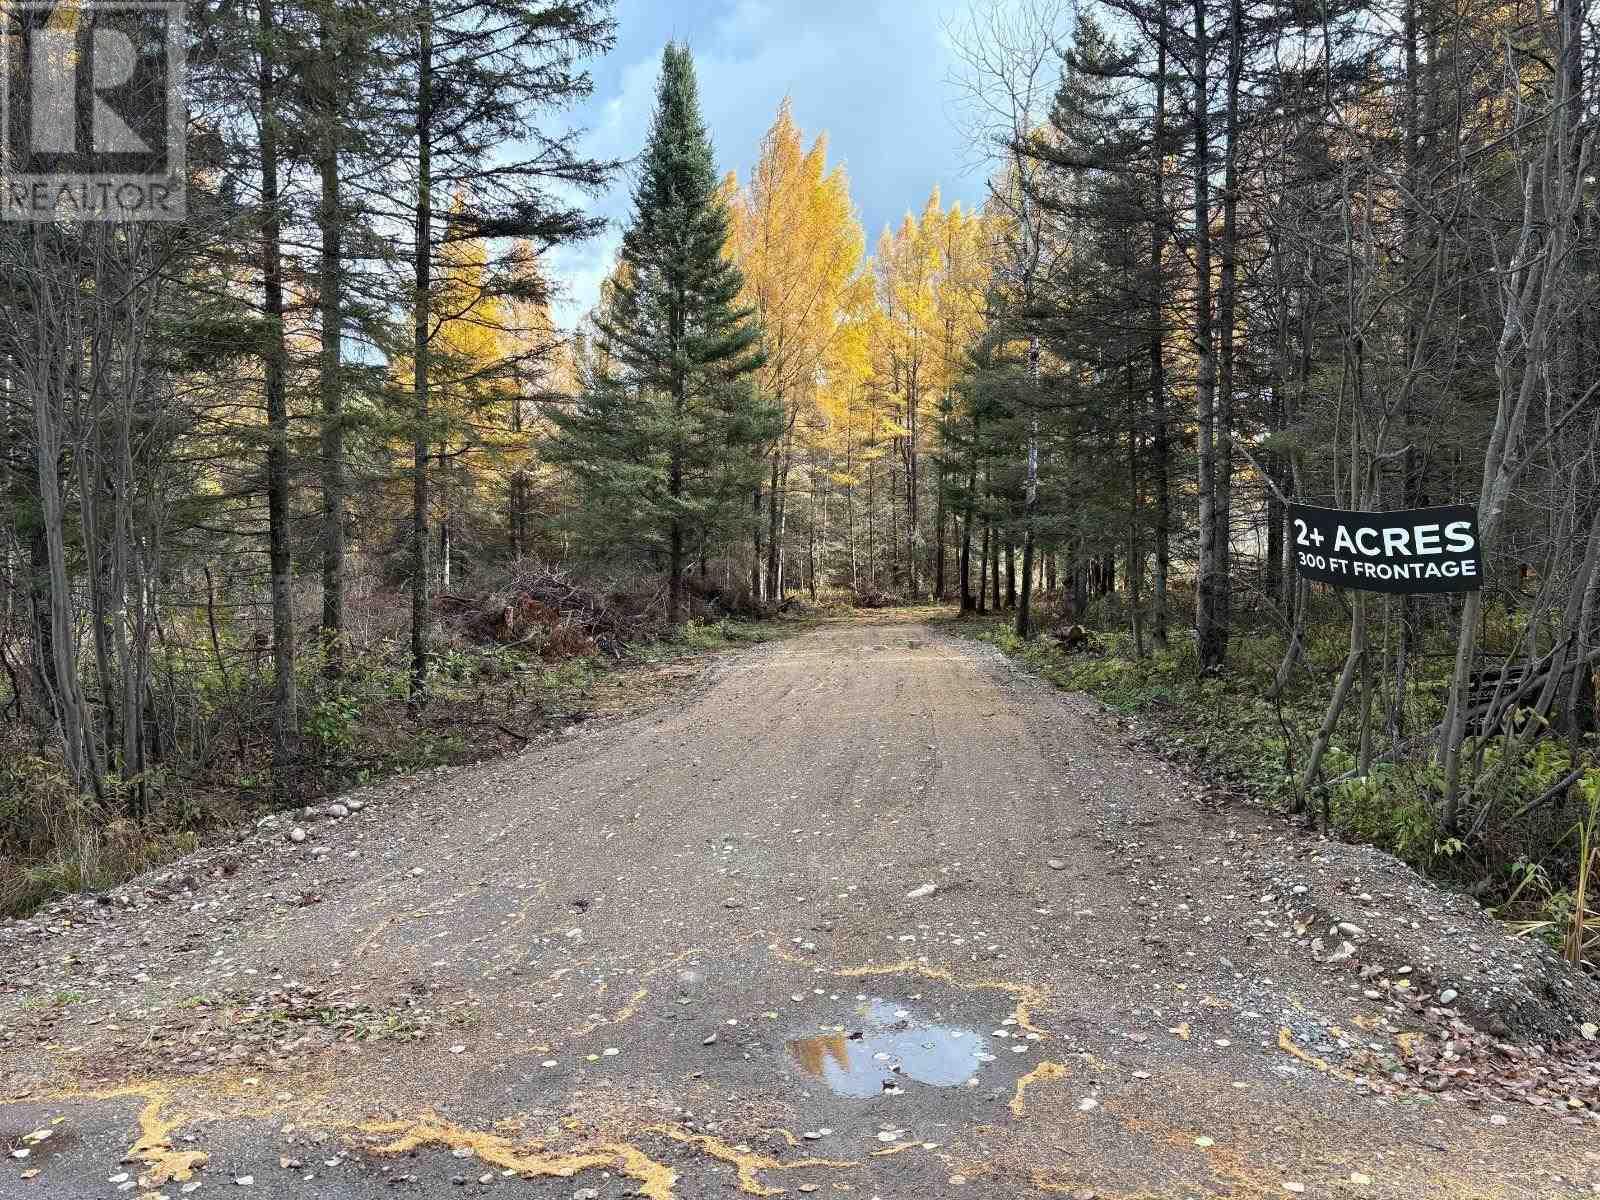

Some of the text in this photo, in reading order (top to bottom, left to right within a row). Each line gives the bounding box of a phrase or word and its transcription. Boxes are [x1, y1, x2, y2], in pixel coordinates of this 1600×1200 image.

[1294, 518, 1475, 557] 2+ ACRES
[1299, 551, 1477, 580] 300 FT FRONTAGE
